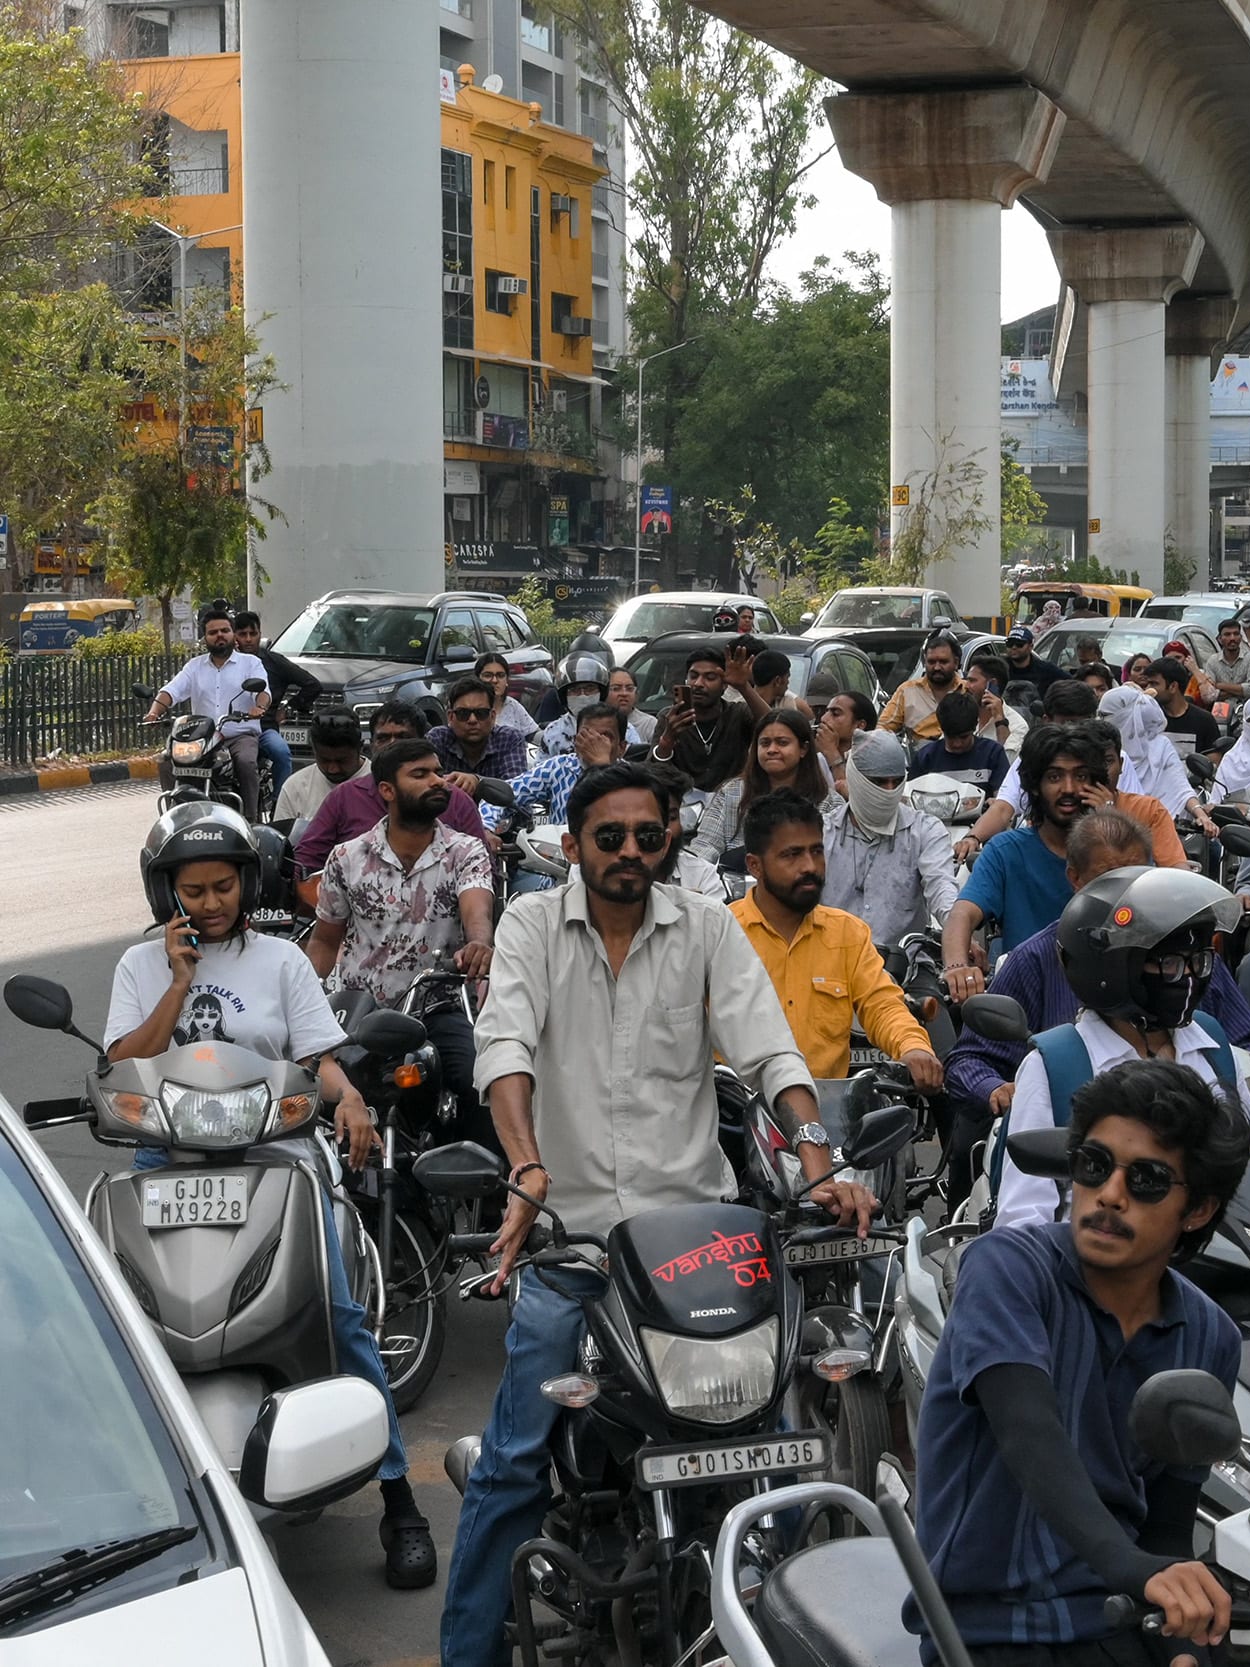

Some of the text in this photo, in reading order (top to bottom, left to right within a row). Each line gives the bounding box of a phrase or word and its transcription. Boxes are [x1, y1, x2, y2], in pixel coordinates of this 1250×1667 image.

[1031, 402, 1060, 410] Kendra
[550, 501, 567, 511] SPA
[206, 984, 234, 1000] TALK
[231, 997, 246, 1014] RN
[175, 1177, 226, 1200] GJ01
[161, 1200, 241, 1224] MX9228
[727, 1257, 771, 1287] 04
[690, 1307, 737, 1318] HONDA
